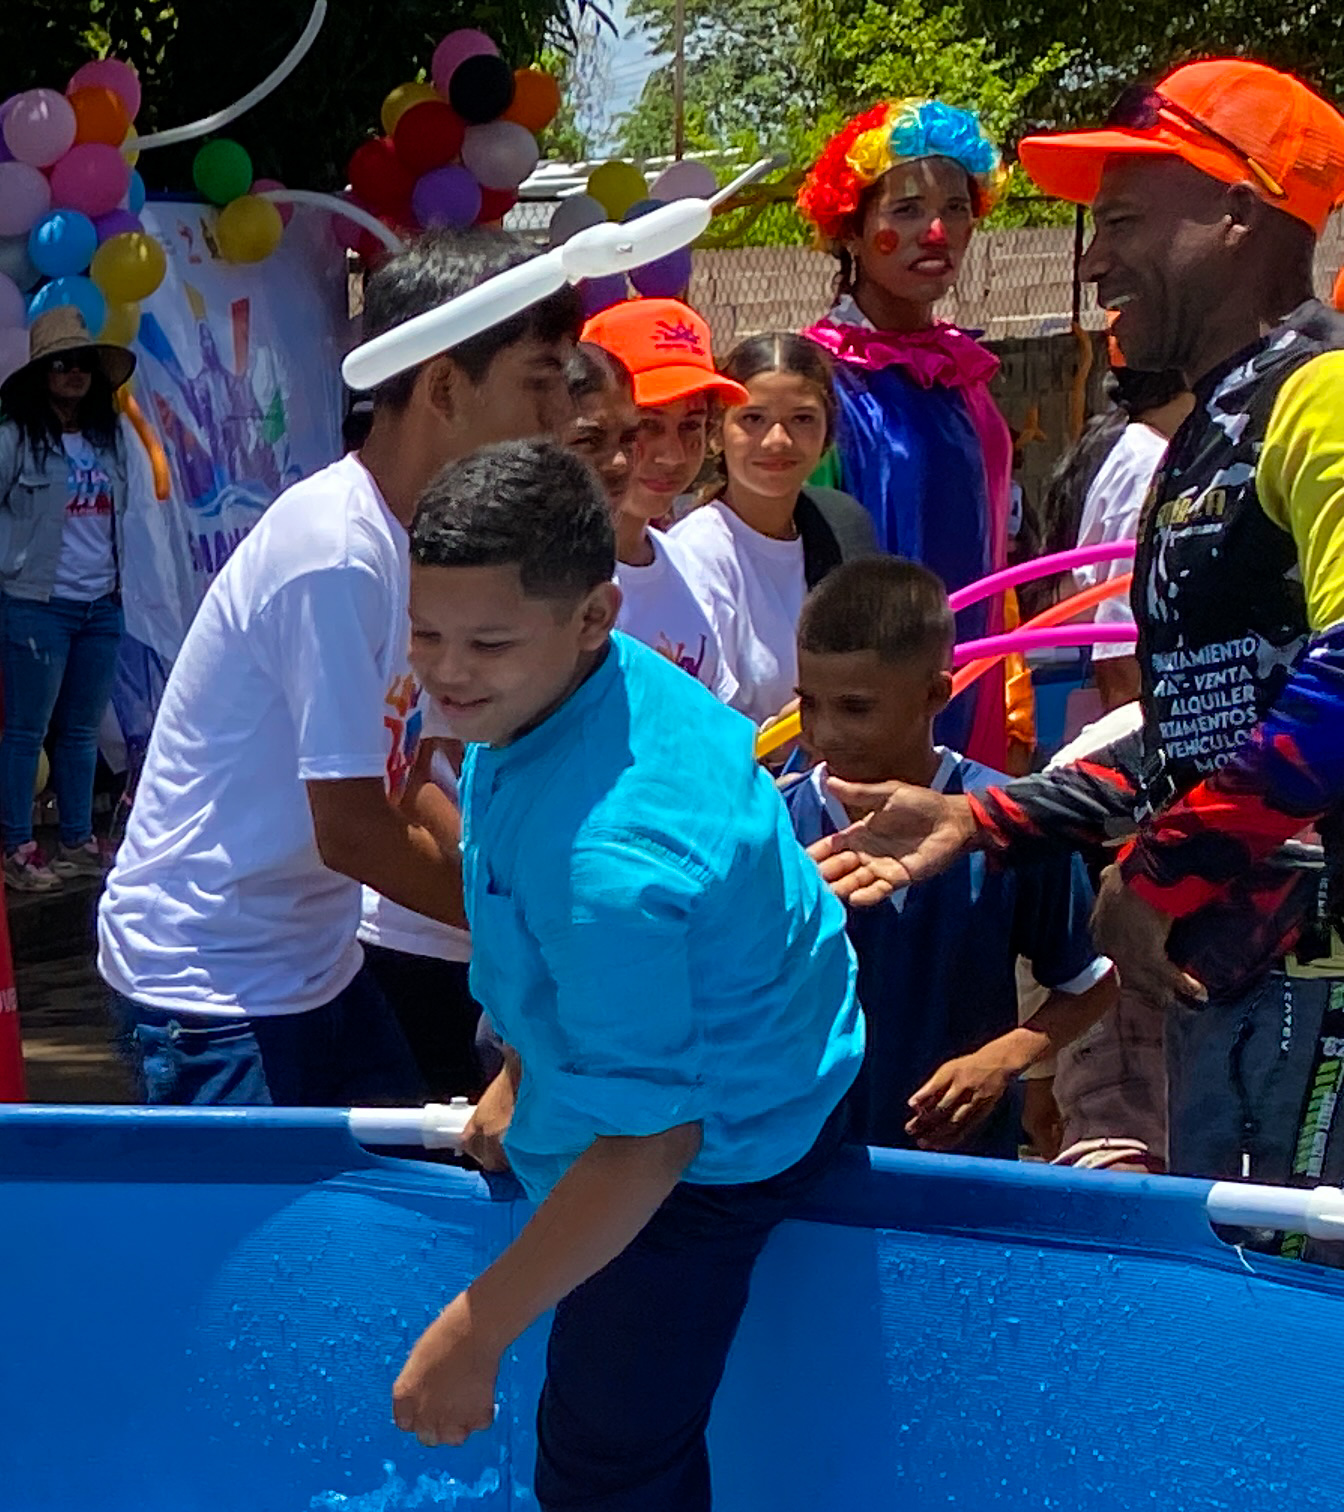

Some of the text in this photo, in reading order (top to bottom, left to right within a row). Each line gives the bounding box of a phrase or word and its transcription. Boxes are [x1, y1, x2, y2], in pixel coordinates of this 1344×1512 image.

[1193, 664, 1253, 692] VENTA
[1170, 684, 1256, 717] ALQUILER
[1166, 728, 1251, 759] VEHICULO
